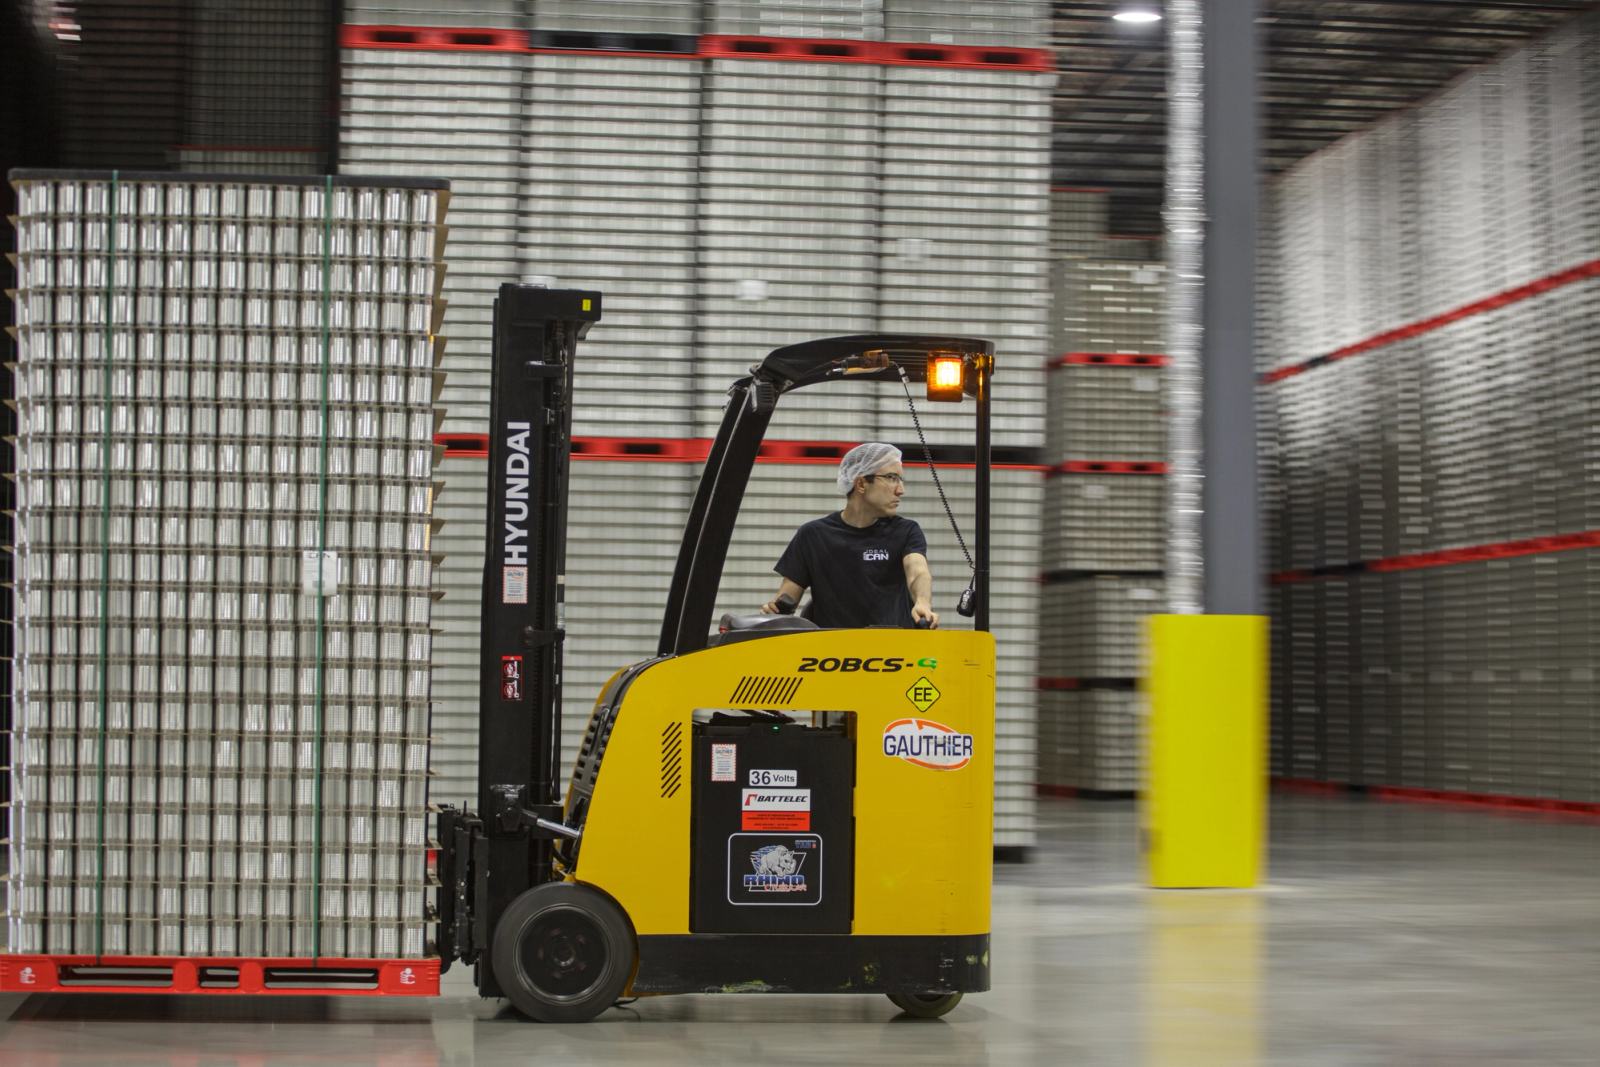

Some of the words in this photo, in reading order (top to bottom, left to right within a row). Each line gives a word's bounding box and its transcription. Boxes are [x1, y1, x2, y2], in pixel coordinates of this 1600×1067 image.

[504, 422, 530, 565] HYUNDAI
[914, 687, 932, 702] EE
[884, 735, 972, 757] GAUTHIER
[751, 771, 771, 785] 36
[773, 774, 795, 783] Volts
[757, 795, 808, 803] BATTELEC
[743, 874, 805, 887] RHINO
